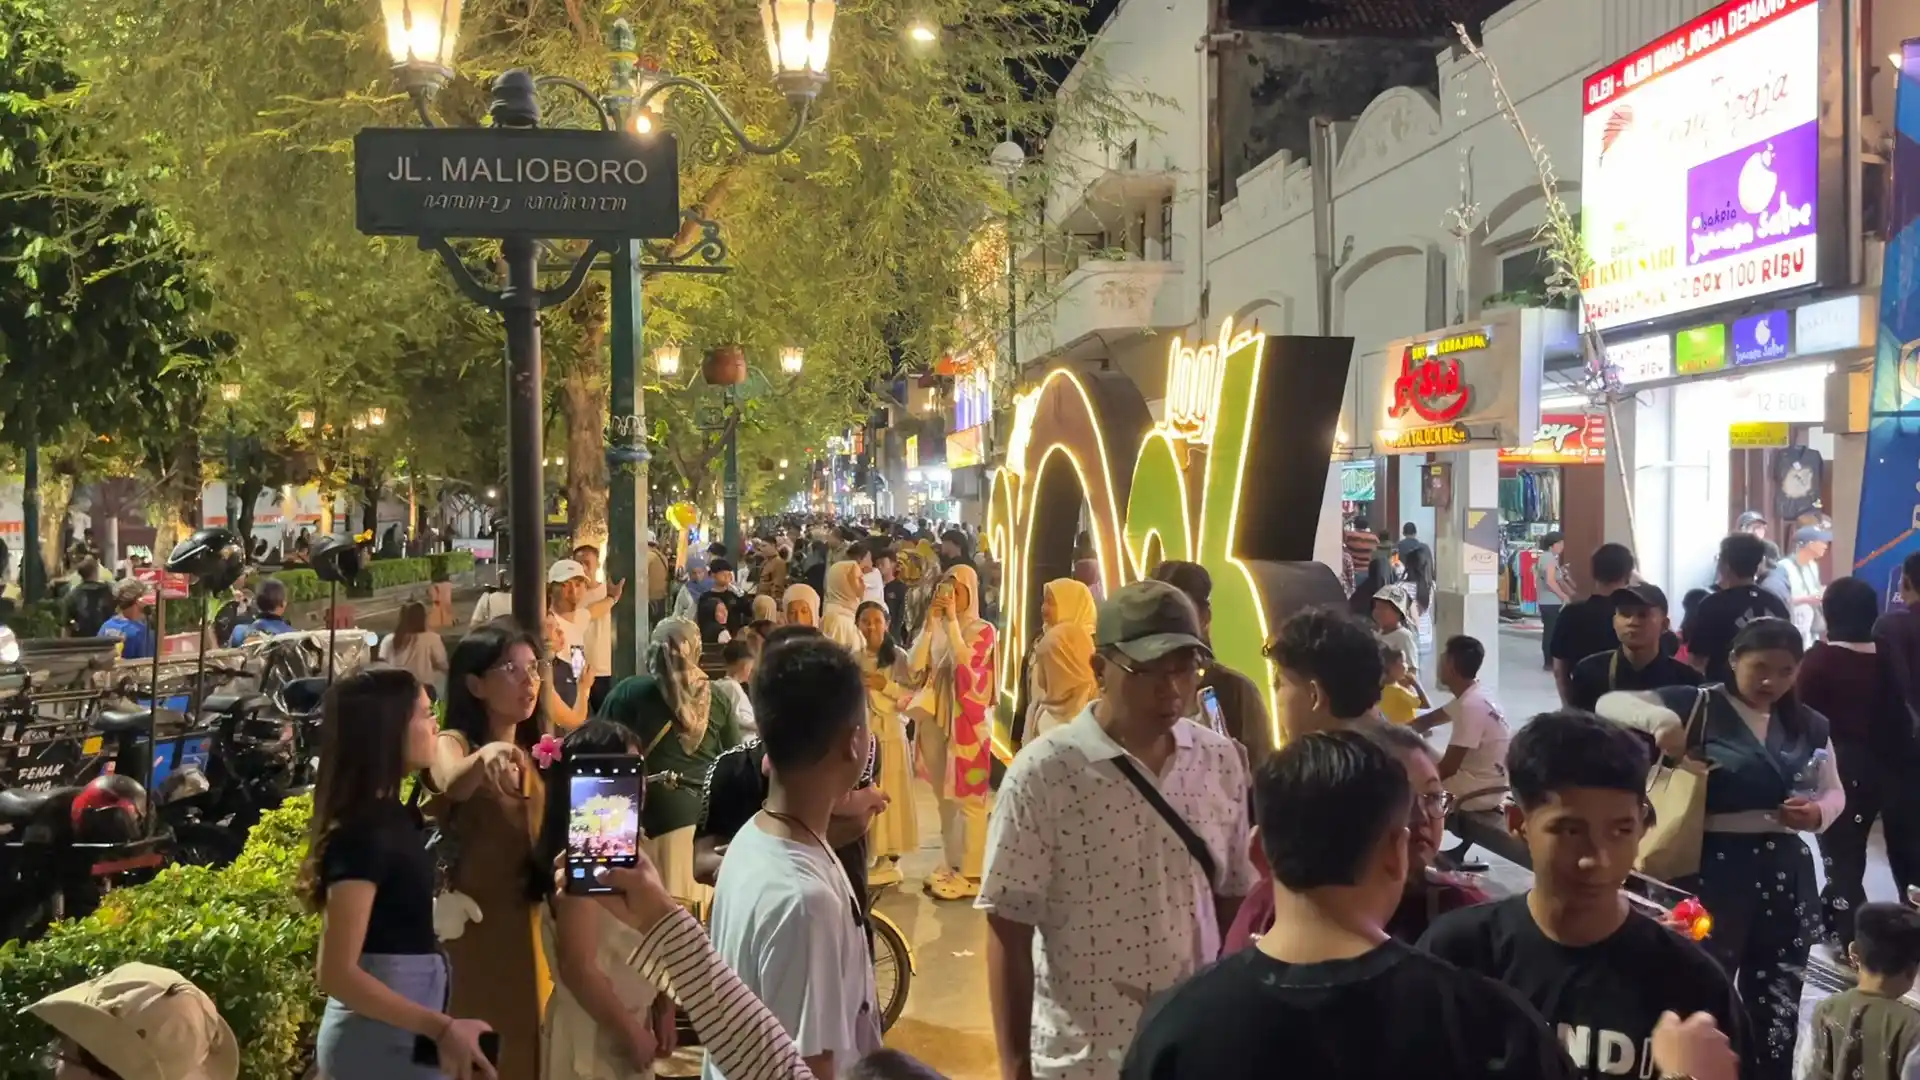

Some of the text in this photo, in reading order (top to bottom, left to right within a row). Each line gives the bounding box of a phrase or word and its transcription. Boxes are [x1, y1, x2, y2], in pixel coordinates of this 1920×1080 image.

[388, 155, 648, 186] JL. MALIOBORO
[1760, 246, 1806, 285] RIBU
